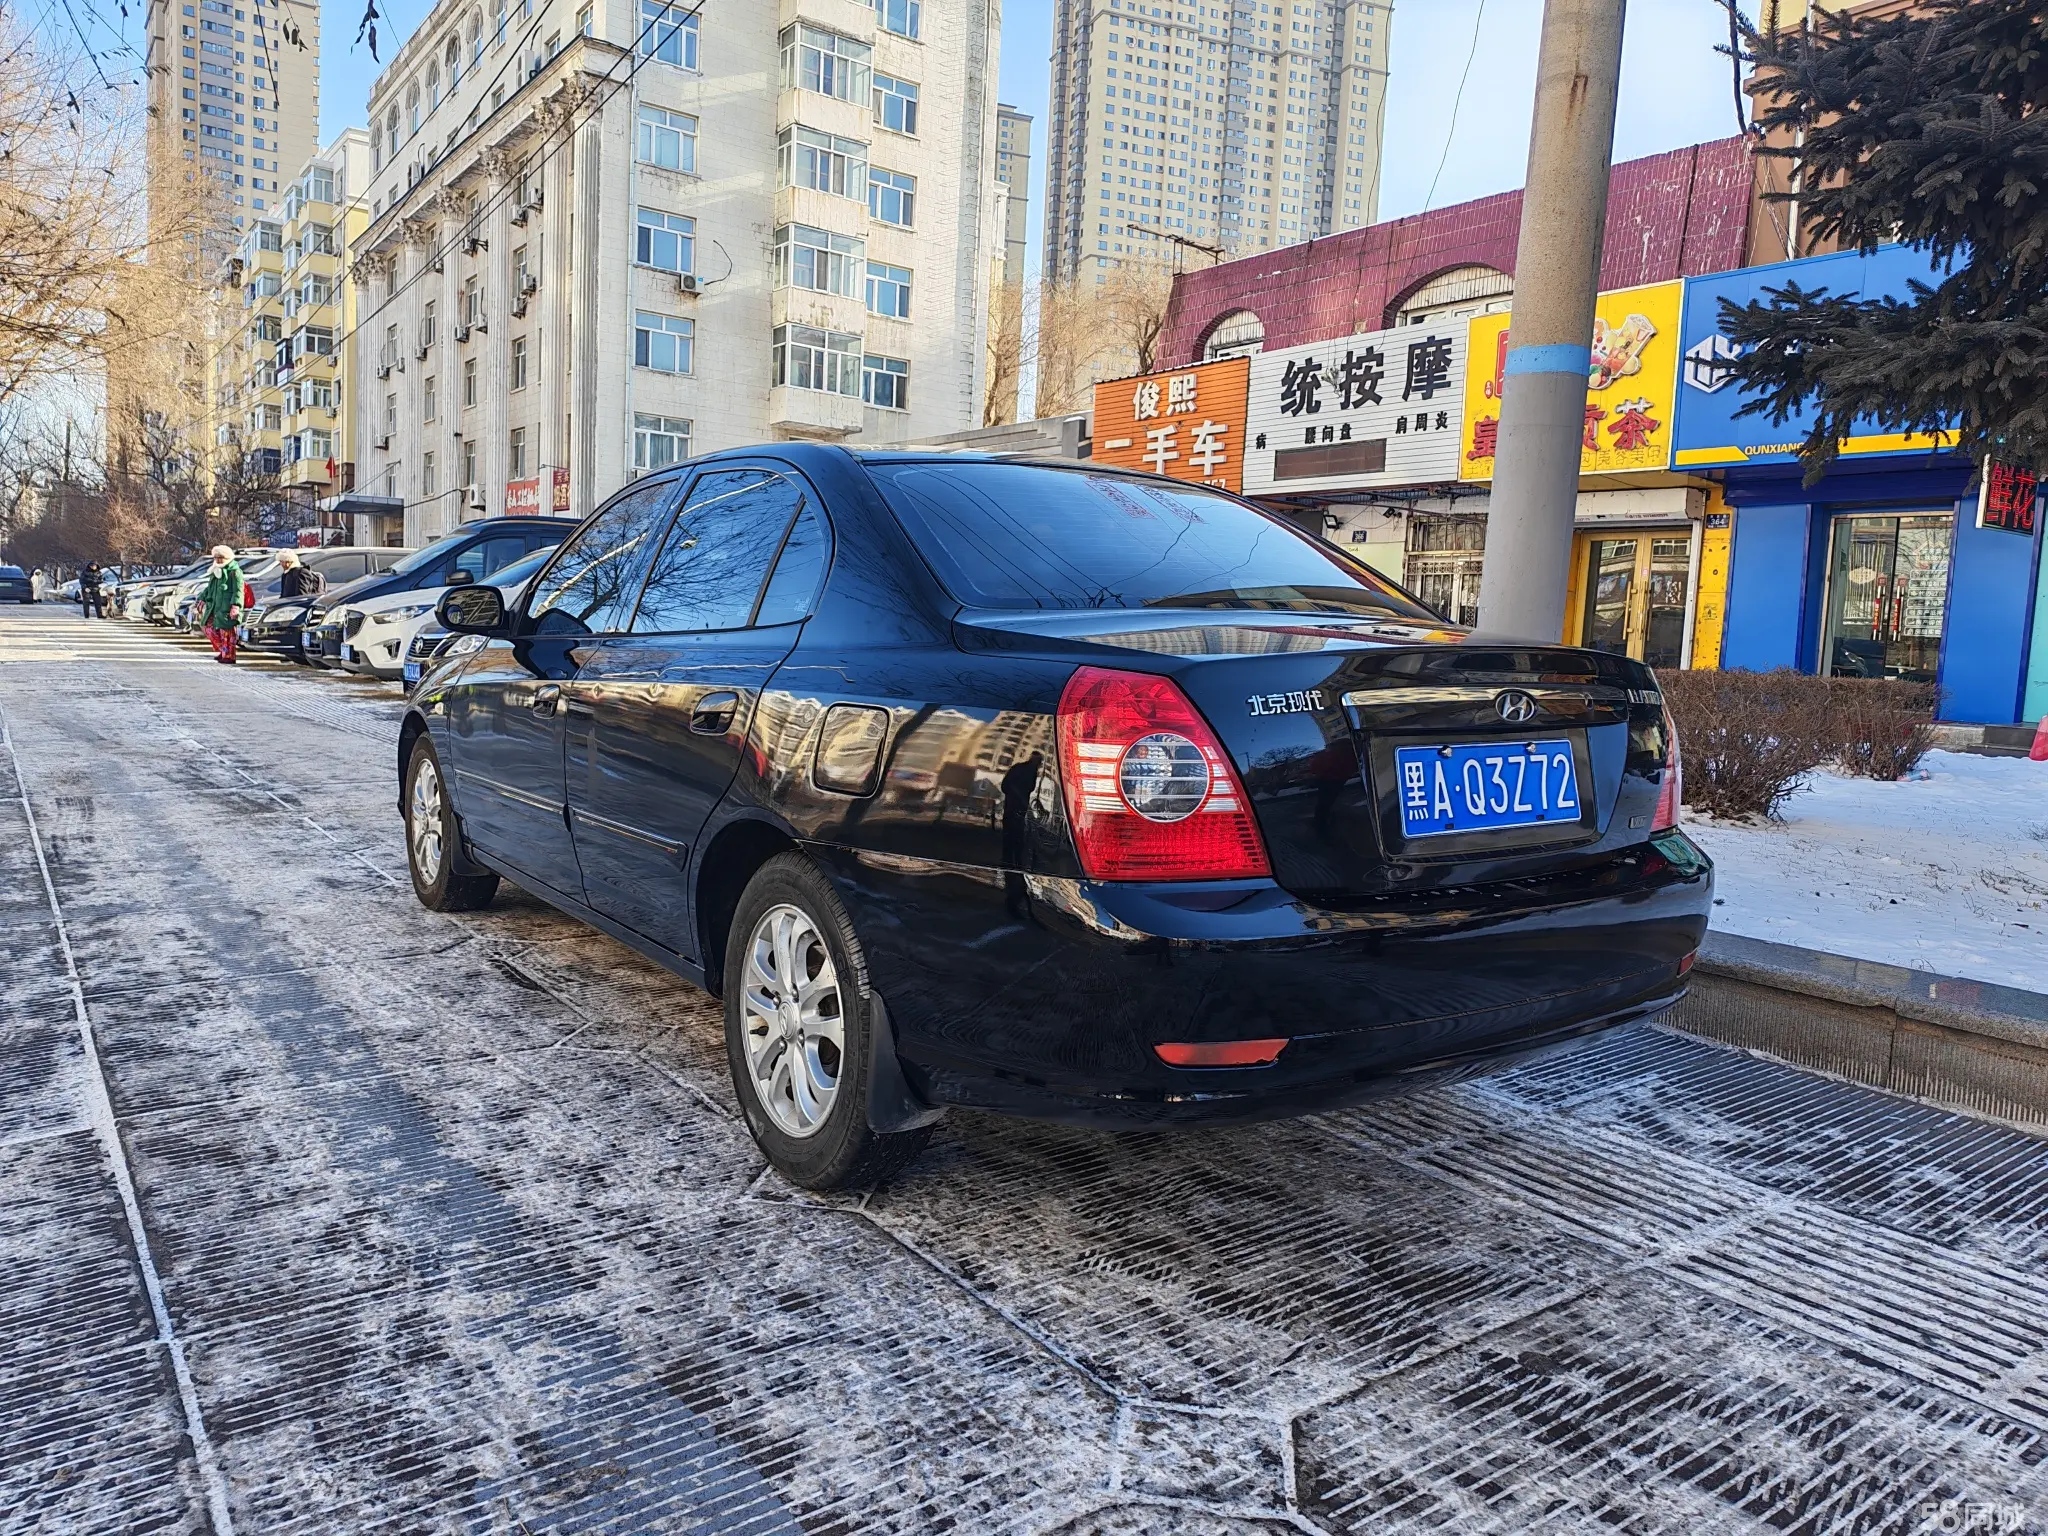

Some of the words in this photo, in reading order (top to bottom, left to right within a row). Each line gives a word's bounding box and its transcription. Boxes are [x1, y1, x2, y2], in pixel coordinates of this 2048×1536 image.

[1133, 373, 1197, 420] 俊熙
[1281, 336, 1452, 417] 统按摩
[1256, 433, 1267, 449] 病
[1305, 423, 1352, 444] 腰间盘
[1396, 411, 1448, 434] 肩周炎
[1987, 461, 2037, 528] 鲜花
[1247, 690, 1325, 716] 北京现代
